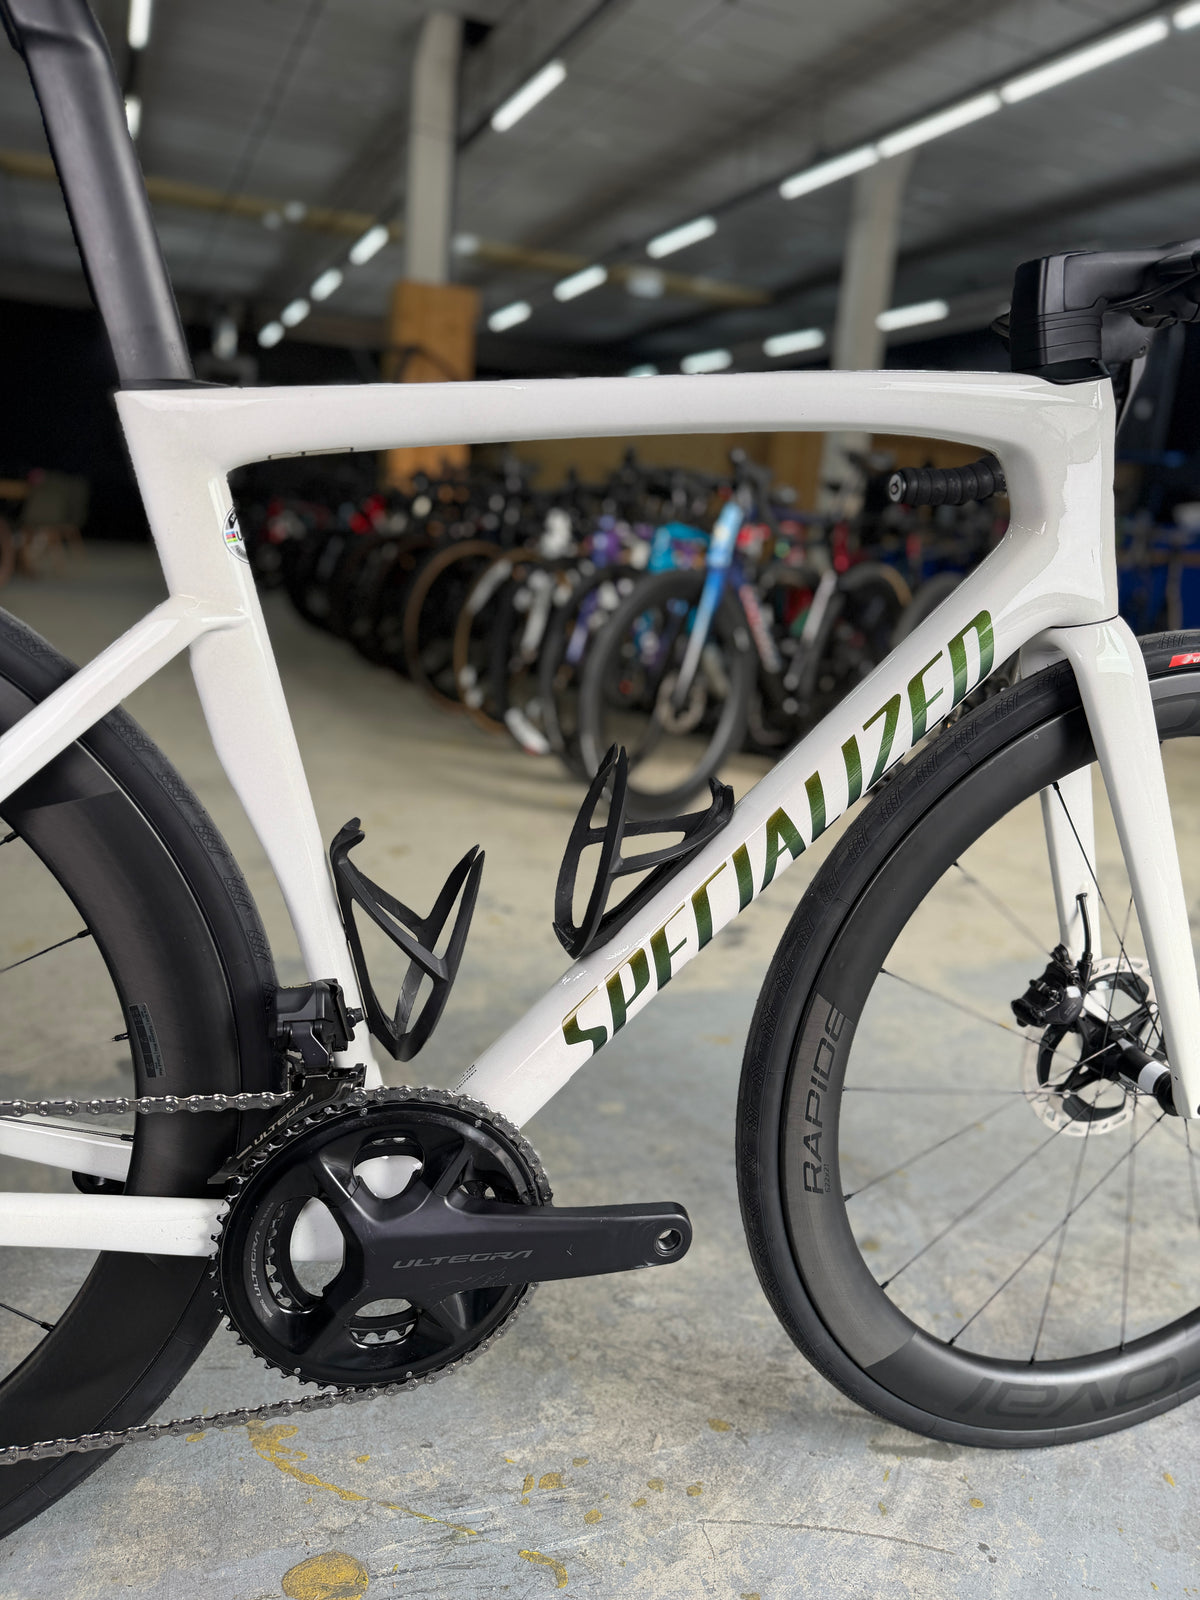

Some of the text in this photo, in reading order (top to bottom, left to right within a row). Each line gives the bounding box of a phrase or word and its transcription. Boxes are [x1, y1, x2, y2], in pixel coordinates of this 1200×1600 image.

[562, 609, 995, 1054] SPECIALIZED
[253, 1093, 314, 1146] ULTEGRA
[803, 1004, 848, 1195] RAPIDE
[250, 1230, 262, 1297] ULTEGRA
[392, 1249, 534, 1269] ULTEGRA
